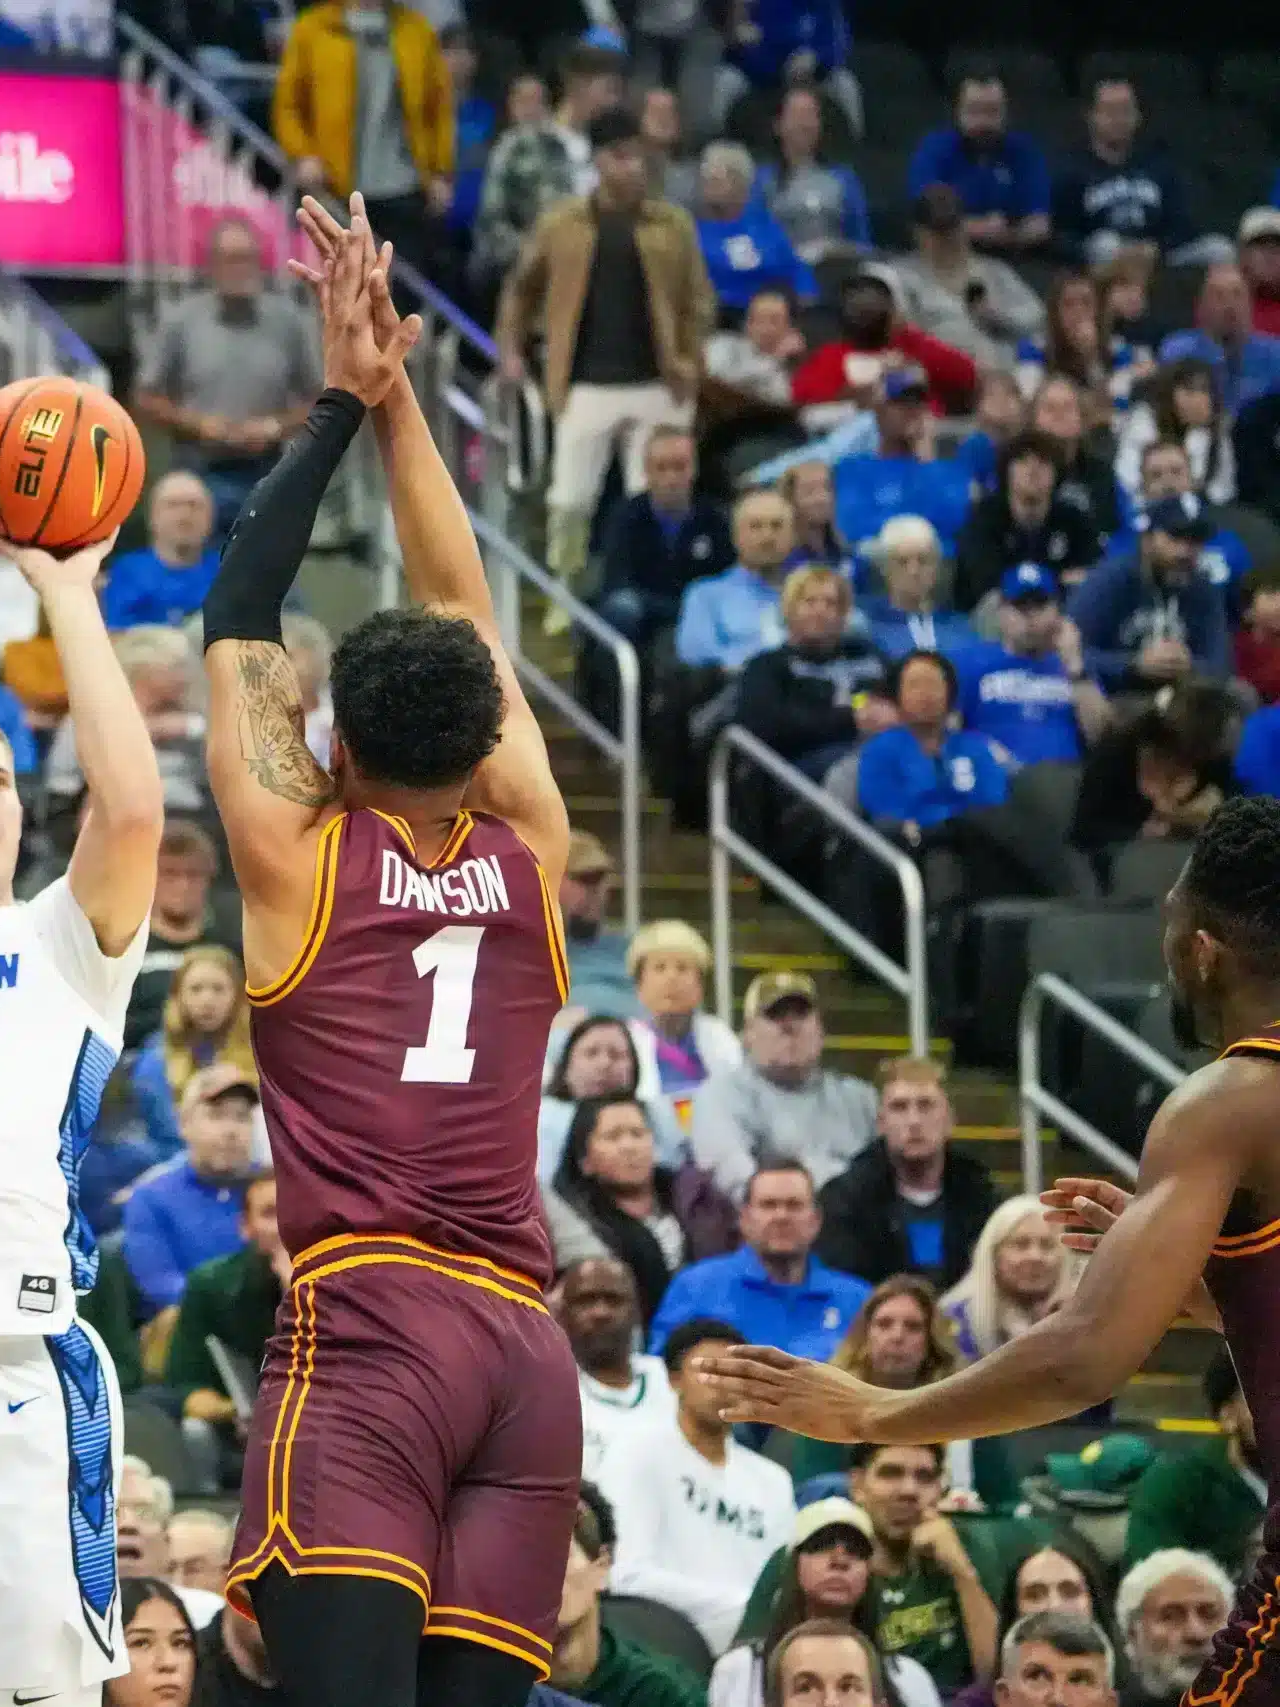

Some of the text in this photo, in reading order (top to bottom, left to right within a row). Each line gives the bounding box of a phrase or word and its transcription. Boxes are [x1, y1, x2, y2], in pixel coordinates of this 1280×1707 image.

[14, 407, 64, 498] ELITE
[379, 849, 511, 917] DAWSON
[400, 925, 487, 1084] 1
[27, 1278, 50, 1291] 46
